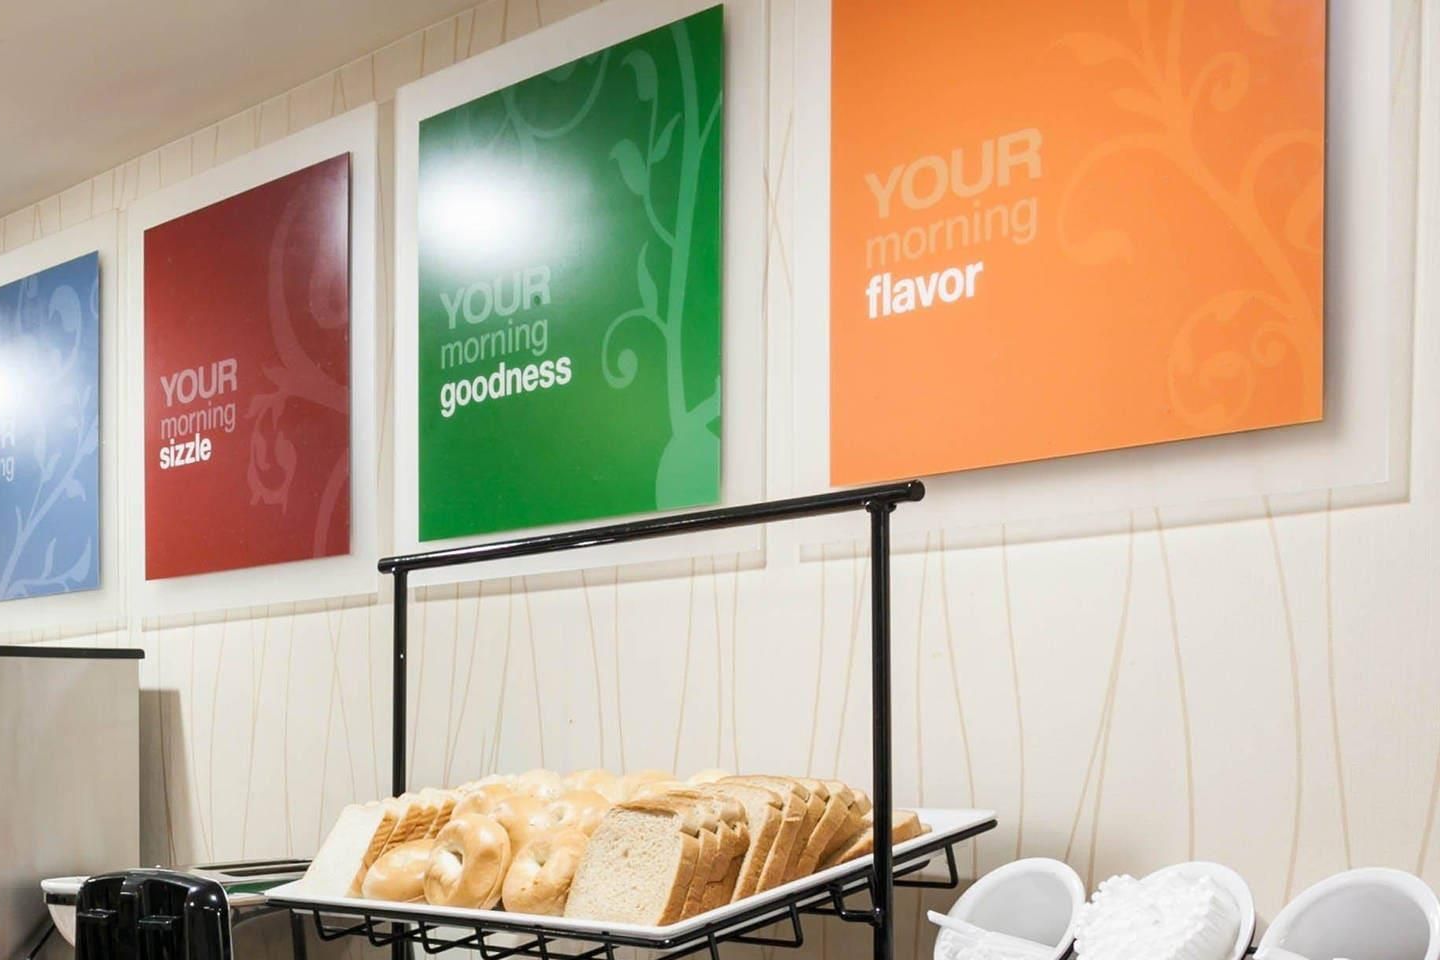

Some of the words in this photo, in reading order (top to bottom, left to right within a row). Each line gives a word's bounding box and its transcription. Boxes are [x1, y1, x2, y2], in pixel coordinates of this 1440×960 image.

[864, 128, 1042, 219] YOUR
[866, 197, 1037, 269] morning
[440, 265, 551, 329] YOUR
[865, 261, 984, 319] flavor
[441, 318, 548, 369] morning
[160, 358, 237, 407] YOUR
[440, 356, 572, 417] goodness
[161, 400, 236, 433] morning
[159, 433, 212, 469] sizzle
